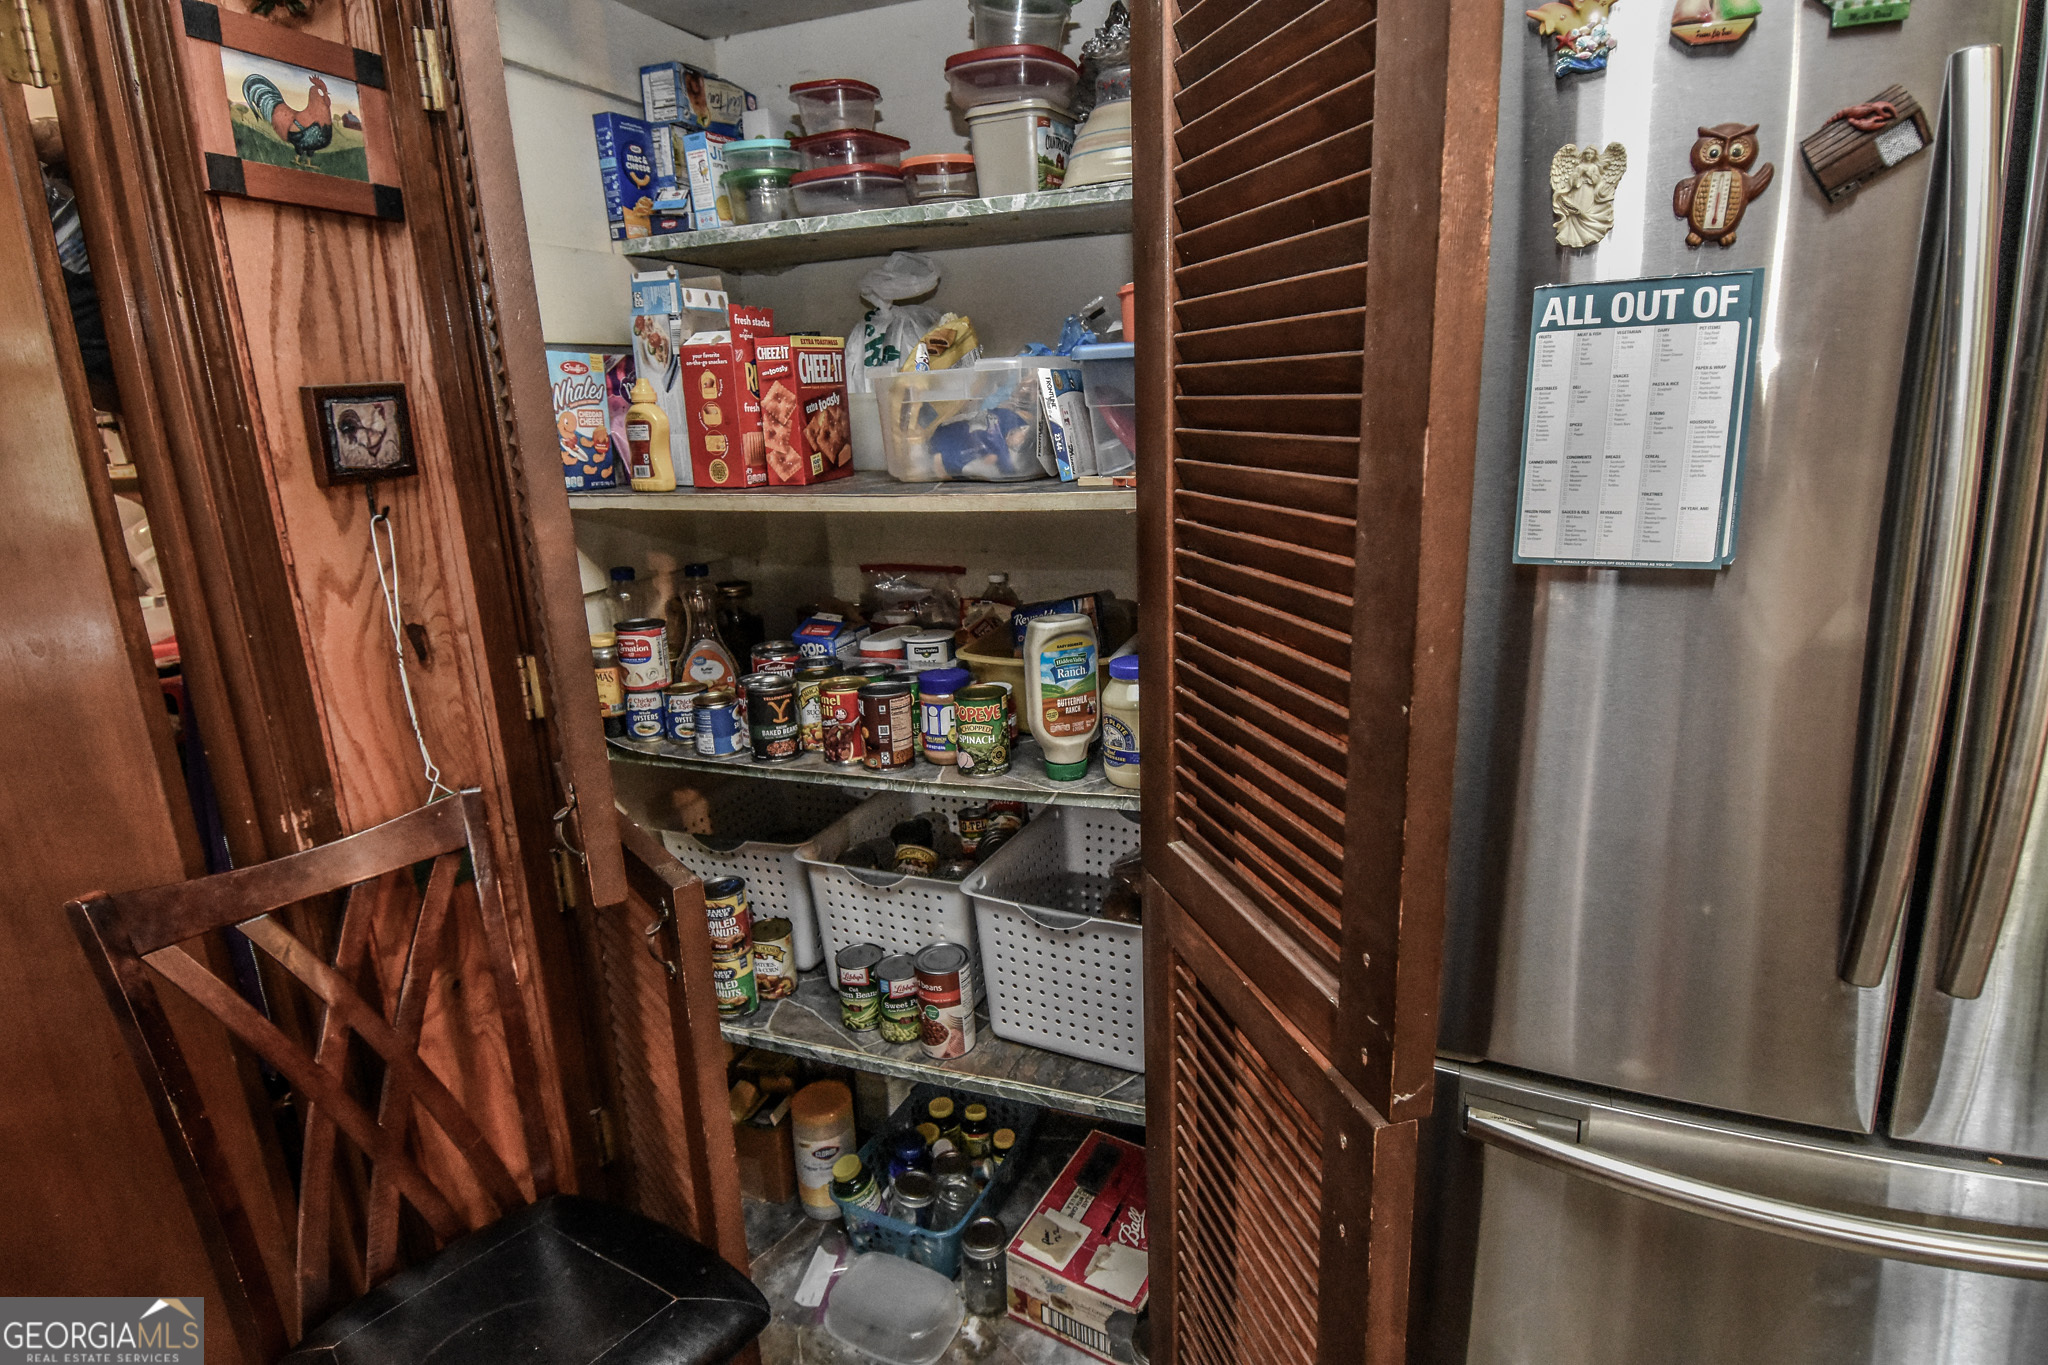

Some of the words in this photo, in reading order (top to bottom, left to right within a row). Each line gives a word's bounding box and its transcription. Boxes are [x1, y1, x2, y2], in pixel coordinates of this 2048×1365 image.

[1540, 294, 1601, 327] ALL
[1611, 288, 1684, 323] OUT
[1693, 284, 1740, 318] OF
[734, 314, 751, 326] fresh
[752, 316, 770, 328] stacks
[744, 402, 760, 412] fresh
[818, 392, 840, 411] toasty
[580, 417, 603, 426] CHEESE
[1057, 695, 1088, 708] BUTTERMILK
[954, 702, 1000, 722] POPEYE
[1066, 705, 1081, 714] RANCH
[633, 713, 658, 721] OYSTERS
[959, 735, 995, 744] SPINACH
[709, 917, 736, 929] OILED
[709, 926, 740, 937] EANUTS
[921, 982, 942, 991] beans
[1119, 1206, 1146, 1246] Ball
